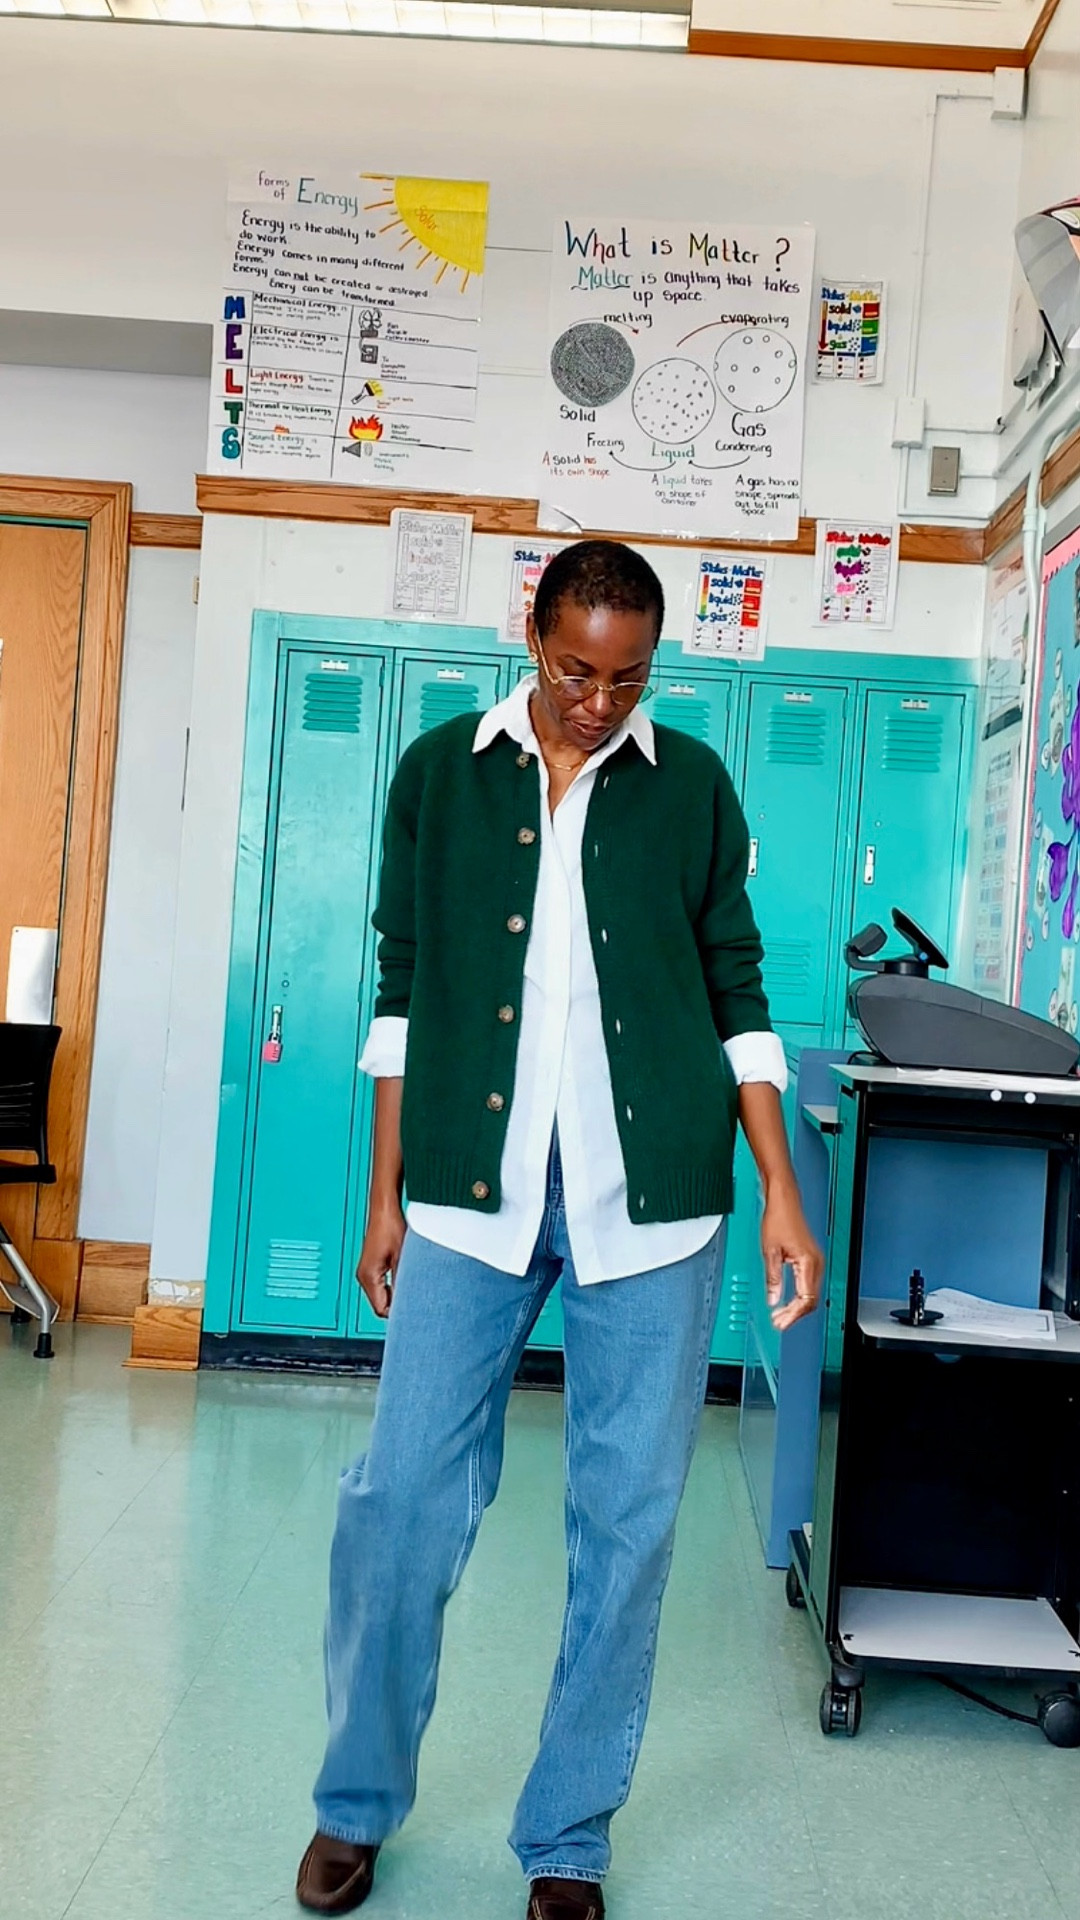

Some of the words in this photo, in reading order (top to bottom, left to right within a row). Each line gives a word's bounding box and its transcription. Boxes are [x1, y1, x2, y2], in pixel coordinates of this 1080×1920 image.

[273, 188, 285, 200] of
[297, 177, 358, 218] Energy
[239, 229, 253, 240] do
[242, 209, 285, 234] Energy
[290, 222, 301, 231] is
[305, 222, 322, 234] the
[324, 227, 359, 245] ability
[365, 229, 377, 238] to
[565, 220, 632, 264] What
[652, 236, 673, 256] is
[689, 232, 760, 266] Matter
[775, 237, 791, 273] ?
[237, 240, 275, 257] Energy
[282, 249, 313, 261] comes
[317, 255, 328, 263] in
[330, 256, 359, 269] many
[362, 258, 405, 271] different
[233, 263, 268, 278] Energy
[314, 274, 327, 283] be
[331, 277, 371, 290] created
[577, 266, 634, 289] Matter
[641, 273, 657, 285] is
[726, 272, 752, 287] that
[765, 276, 801, 294] takes
[322, 286, 334, 295] be
[633, 290, 654, 308] up
[224, 295, 245, 320] M
[828, 302, 852, 315] solid
[603, 313, 653, 328] melting
[827, 319, 852, 335] liquid
[253, 325, 298, 337] Electrical
[225, 324, 243, 360] E
[829, 340, 847, 350] gas
[225, 368, 244, 394] L
[250, 368, 273, 382] Light
[275, 371, 303, 383] Energy
[224, 402, 244, 425] T
[559, 404, 596, 422] Solid
[731, 412, 767, 437] Gas
[221, 427, 242, 460] S
[587, 432, 625, 452] Freezing
[715, 439, 772, 457] Condensing
[542, 450, 550, 466] A
[651, 441, 695, 463] Liquid
[550, 467, 564, 476] its
[588, 468, 610, 480] shape
[651, 473, 659, 486] A
[663, 475, 687, 489] liquid
[735, 474, 745, 486] A
[747, 477, 766, 491] gas
[768, 476, 786, 486] has
[695, 490, 707, 498] of
[711, 576, 734, 588] solid
[708, 592, 733, 607] liquid
[709, 612, 728, 623] gas
